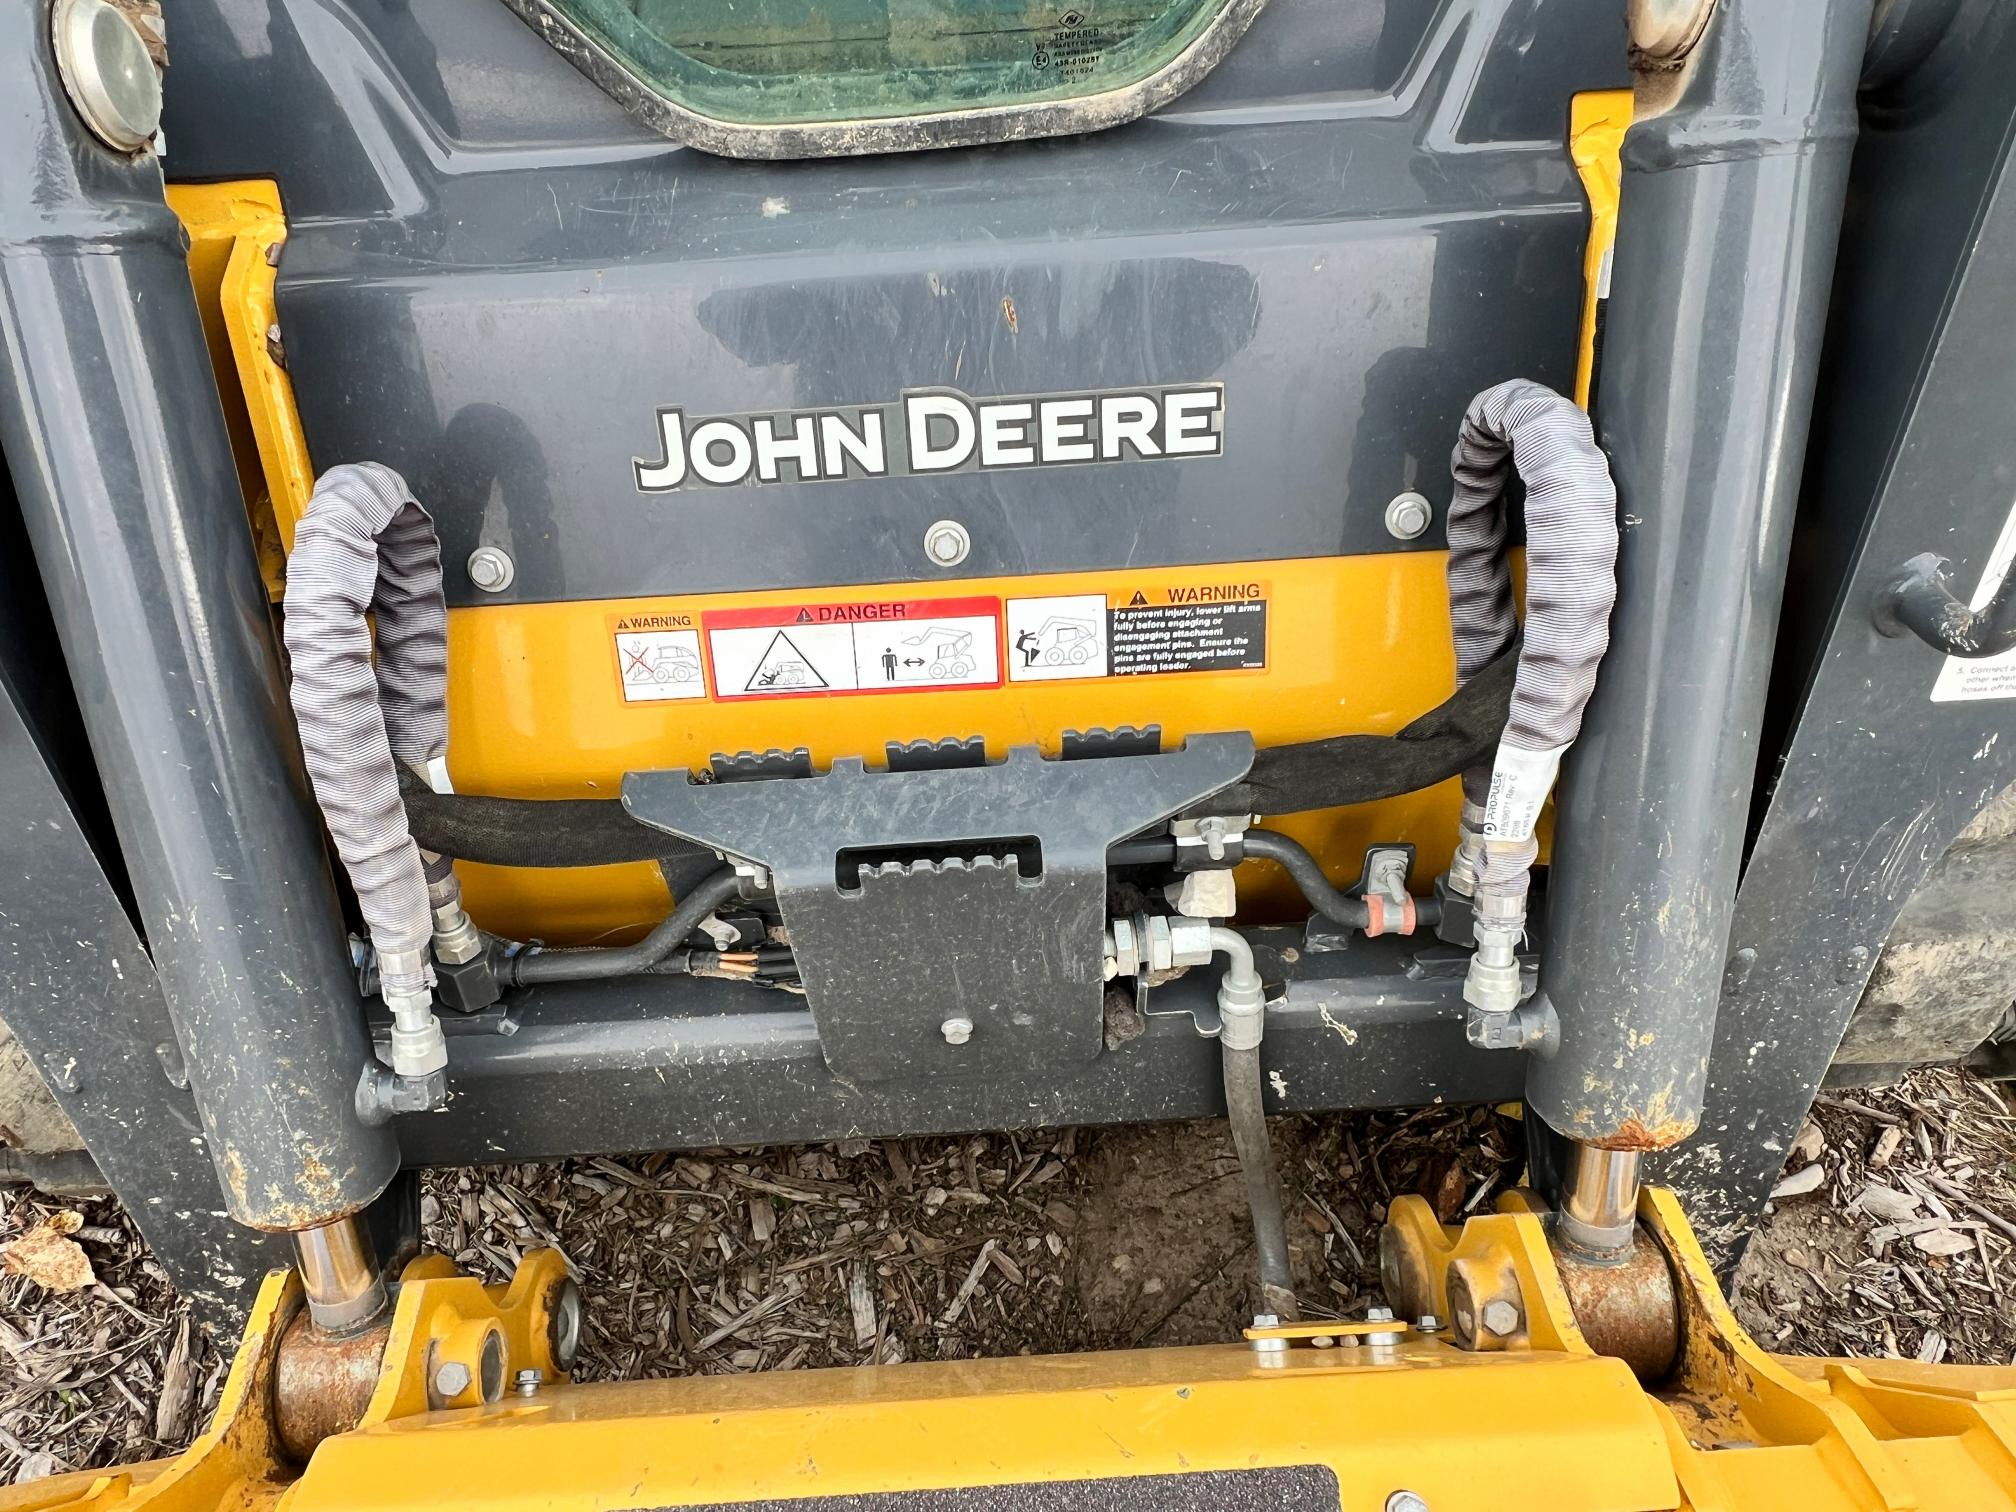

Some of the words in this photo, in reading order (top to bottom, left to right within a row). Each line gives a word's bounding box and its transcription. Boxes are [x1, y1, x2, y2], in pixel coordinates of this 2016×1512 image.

[1054, 28, 1100, 40] TEMPERED
[635, 408, 888, 491] JOHN
[906, 390, 1220, 473] DEERE
[1168, 584, 1260, 603] WARNING
[819, 603, 906, 622] DANGER
[1114, 611, 1126, 620] To
[1128, 609, 1163, 620] prevent
[1165, 607, 1194, 619] injury,
[1196, 605, 1221, 615] lower
[1223, 604, 1236, 614] lift
[1238, 603, 1261, 612] arms
[630, 615, 691, 628] WARNING
[1114, 620, 1134, 632] fully
[1137, 619, 1166, 629] before
[1168, 618, 1210, 629] engaging
[1212, 617, 1223, 625] or
[1114, 630, 1170, 642] disengaging
[1173, 628, 1223, 638] attachment
[1114, 641, 1170, 654] engagement
[1172, 640, 1194, 651] pins.
[1200, 638, 1232, 647] Ensure
[1234, 637, 1249, 645] the
[1114, 653, 1134, 664] pins
[1137, 653, 1151, 662] are
[1153, 650, 1176, 662] fully
[1177, 649, 1214, 660] engaged
[1216, 647, 1245, 657] before
[1114, 662, 1158, 675] operating
[1159, 661, 1191, 671] loader.
[1488, 772, 1503, 819] PROPULSE
